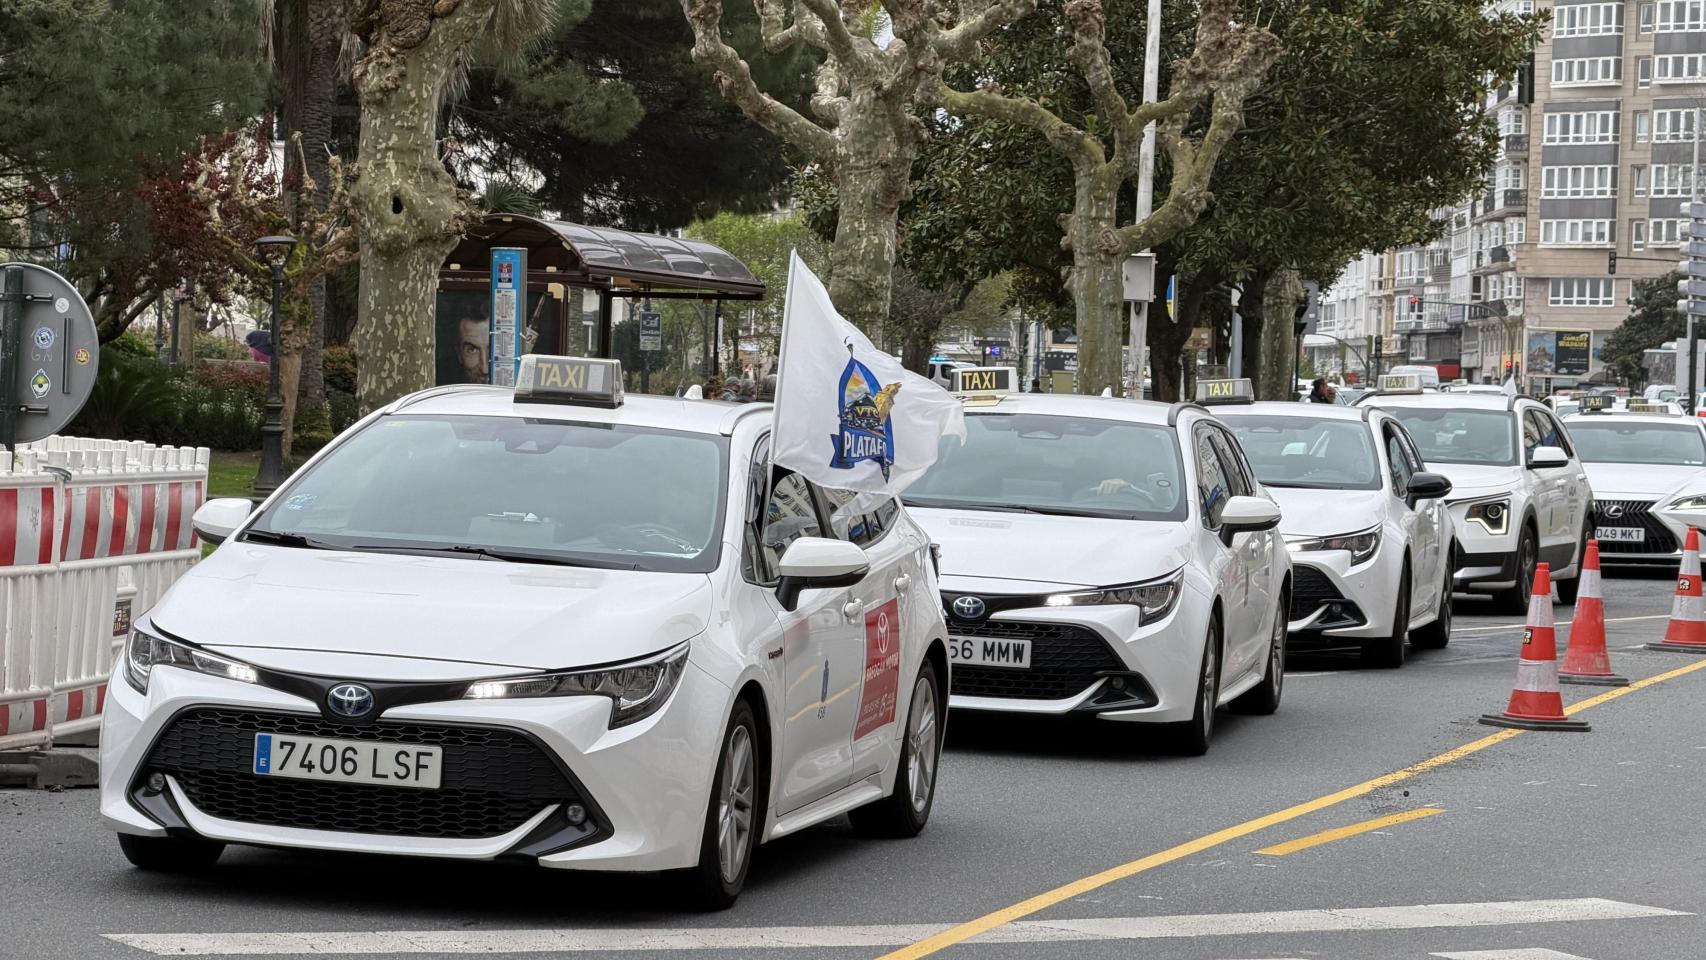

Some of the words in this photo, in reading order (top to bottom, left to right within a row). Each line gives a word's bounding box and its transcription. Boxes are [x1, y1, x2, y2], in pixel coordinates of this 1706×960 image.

[538, 362, 585, 389] TAXI
[962, 371, 996, 390] TAXI
[1385, 376, 1408, 389] TAXI
[1207, 382, 1233, 397] TAXI
[1586, 397, 1603, 407] TAXI
[1596, 528, 1617, 539] 049
[1620, 529, 1642, 540] MKT
[949, 638, 974, 660] 56
[982, 640, 1025, 664] MMW
[260, 758, 267, 767] E
[278, 741, 359, 776] 7406
[371, 748, 434, 782] LSF
